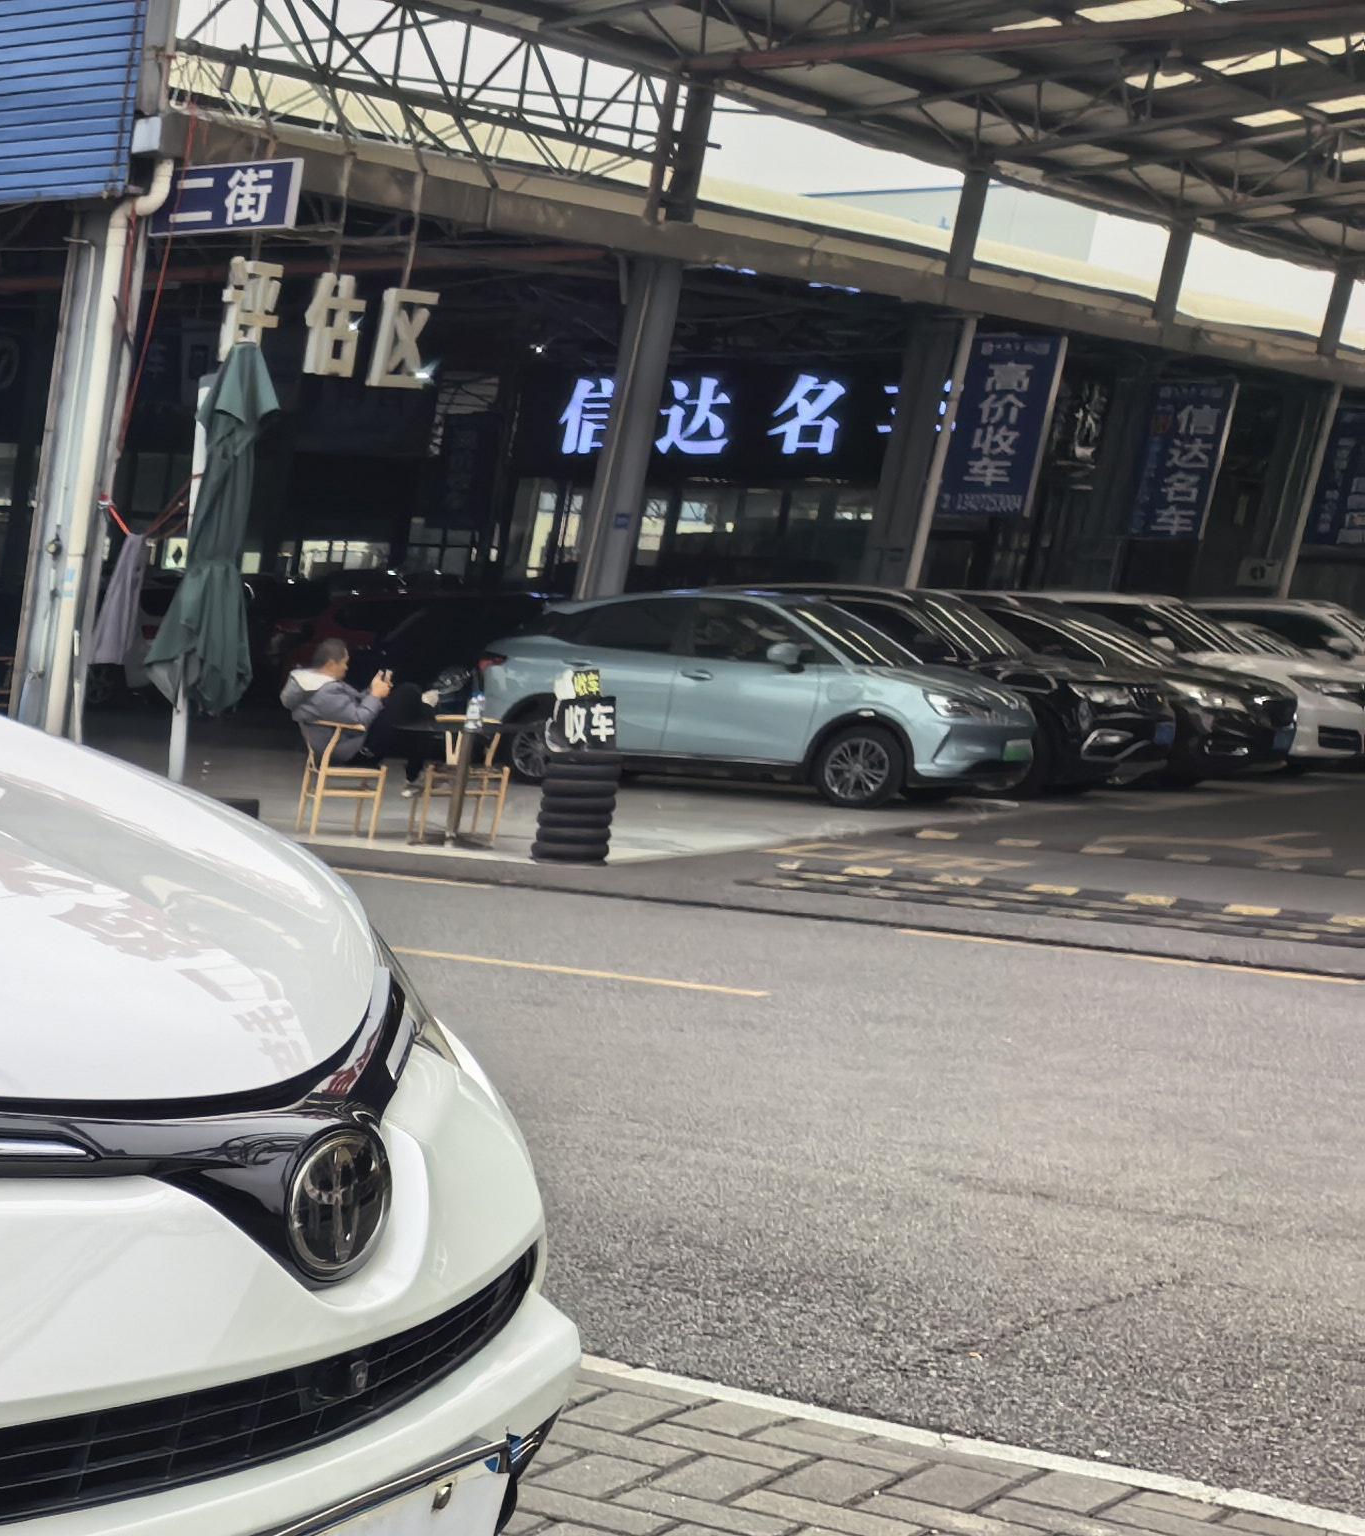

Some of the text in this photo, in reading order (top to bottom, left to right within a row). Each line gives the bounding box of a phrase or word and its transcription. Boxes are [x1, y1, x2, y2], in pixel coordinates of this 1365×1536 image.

[169, 167, 273, 225] 二街
[963, 361, 1034, 487] 高价收车
[564, 703, 615, 745] 收车
